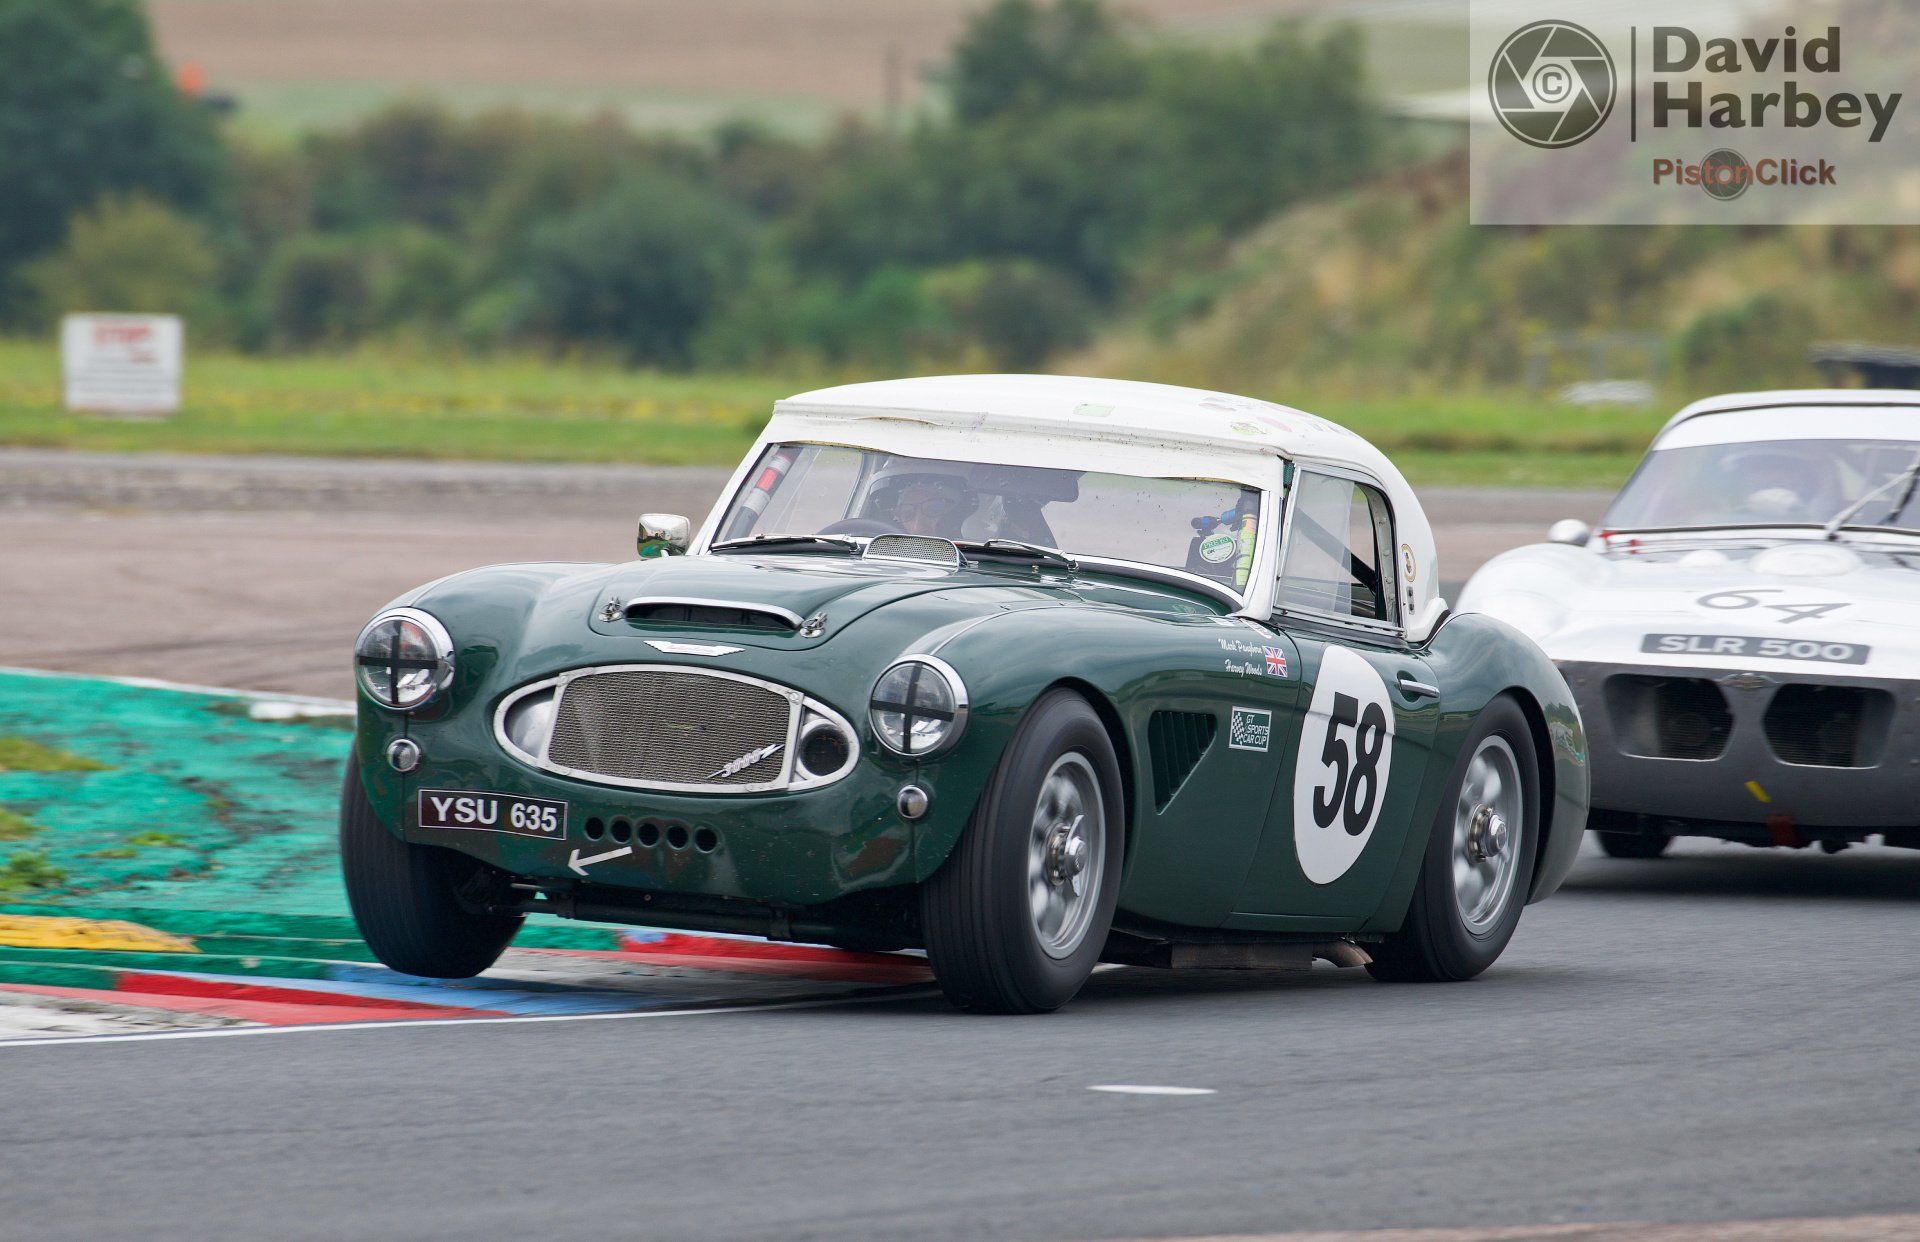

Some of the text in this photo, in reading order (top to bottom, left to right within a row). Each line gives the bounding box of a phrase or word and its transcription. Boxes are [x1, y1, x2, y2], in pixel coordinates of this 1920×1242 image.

[1696, 589, 1853, 624] 64
[1657, 636, 1854, 661] SLR 500
[1243, 733, 1267, 745] CAR CUP
[1247, 724, 1270, 735] SPORTS
[1312, 691, 1387, 836] 58
[430, 797, 557, 832] YSU 635
